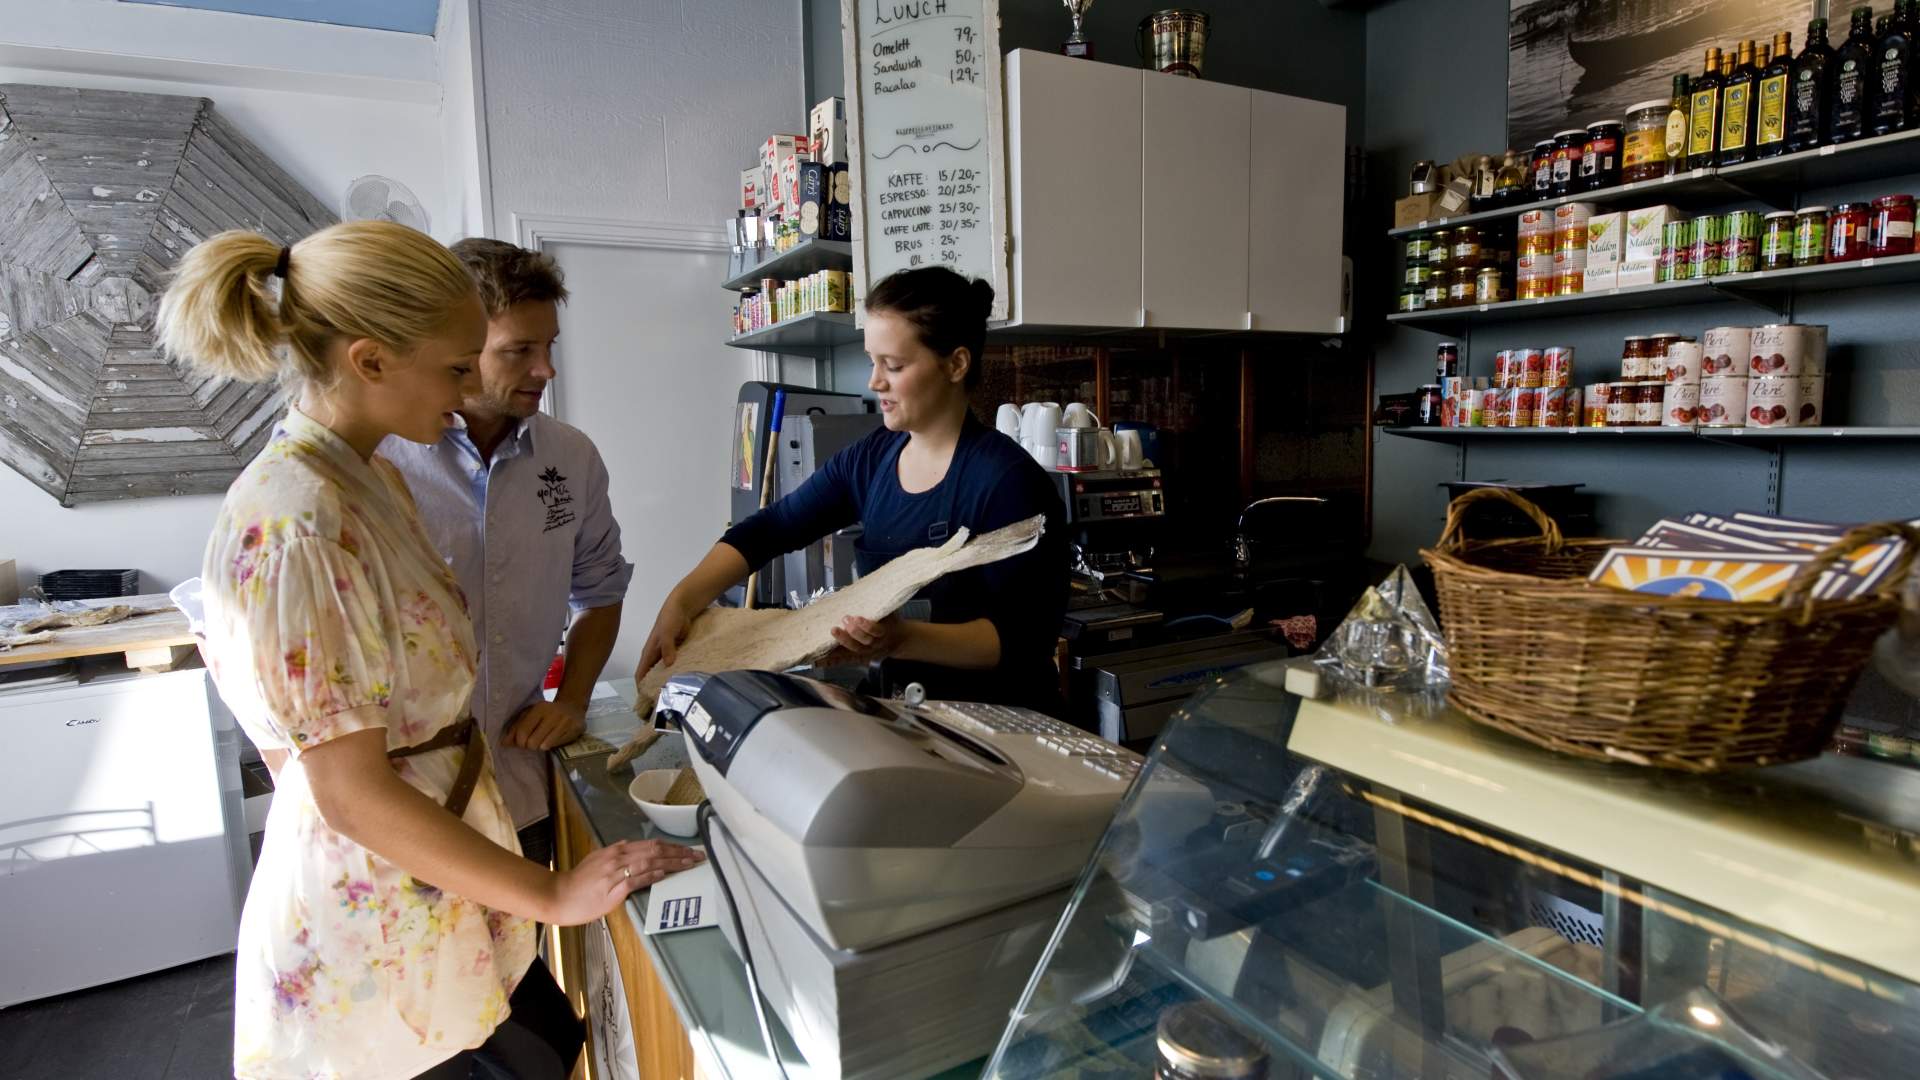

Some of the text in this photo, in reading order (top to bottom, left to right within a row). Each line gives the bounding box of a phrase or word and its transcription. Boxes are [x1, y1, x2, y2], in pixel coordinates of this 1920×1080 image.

[876, 0, 946, 24] LUNCH
[873, 38, 910, 57] Omelett
[874, 56, 922, 76] Sandwich
[875, 78, 916, 95] Bacalao
[884, 225, 909, 236] KAFFE
[895, 239, 922, 253] BRUS
[1589, 241, 1616, 254] Maldon
[910, 254, 924, 266] ØL
[1754, 331, 1784, 345] Puré
[1753, 382, 1784, 396] Puré
